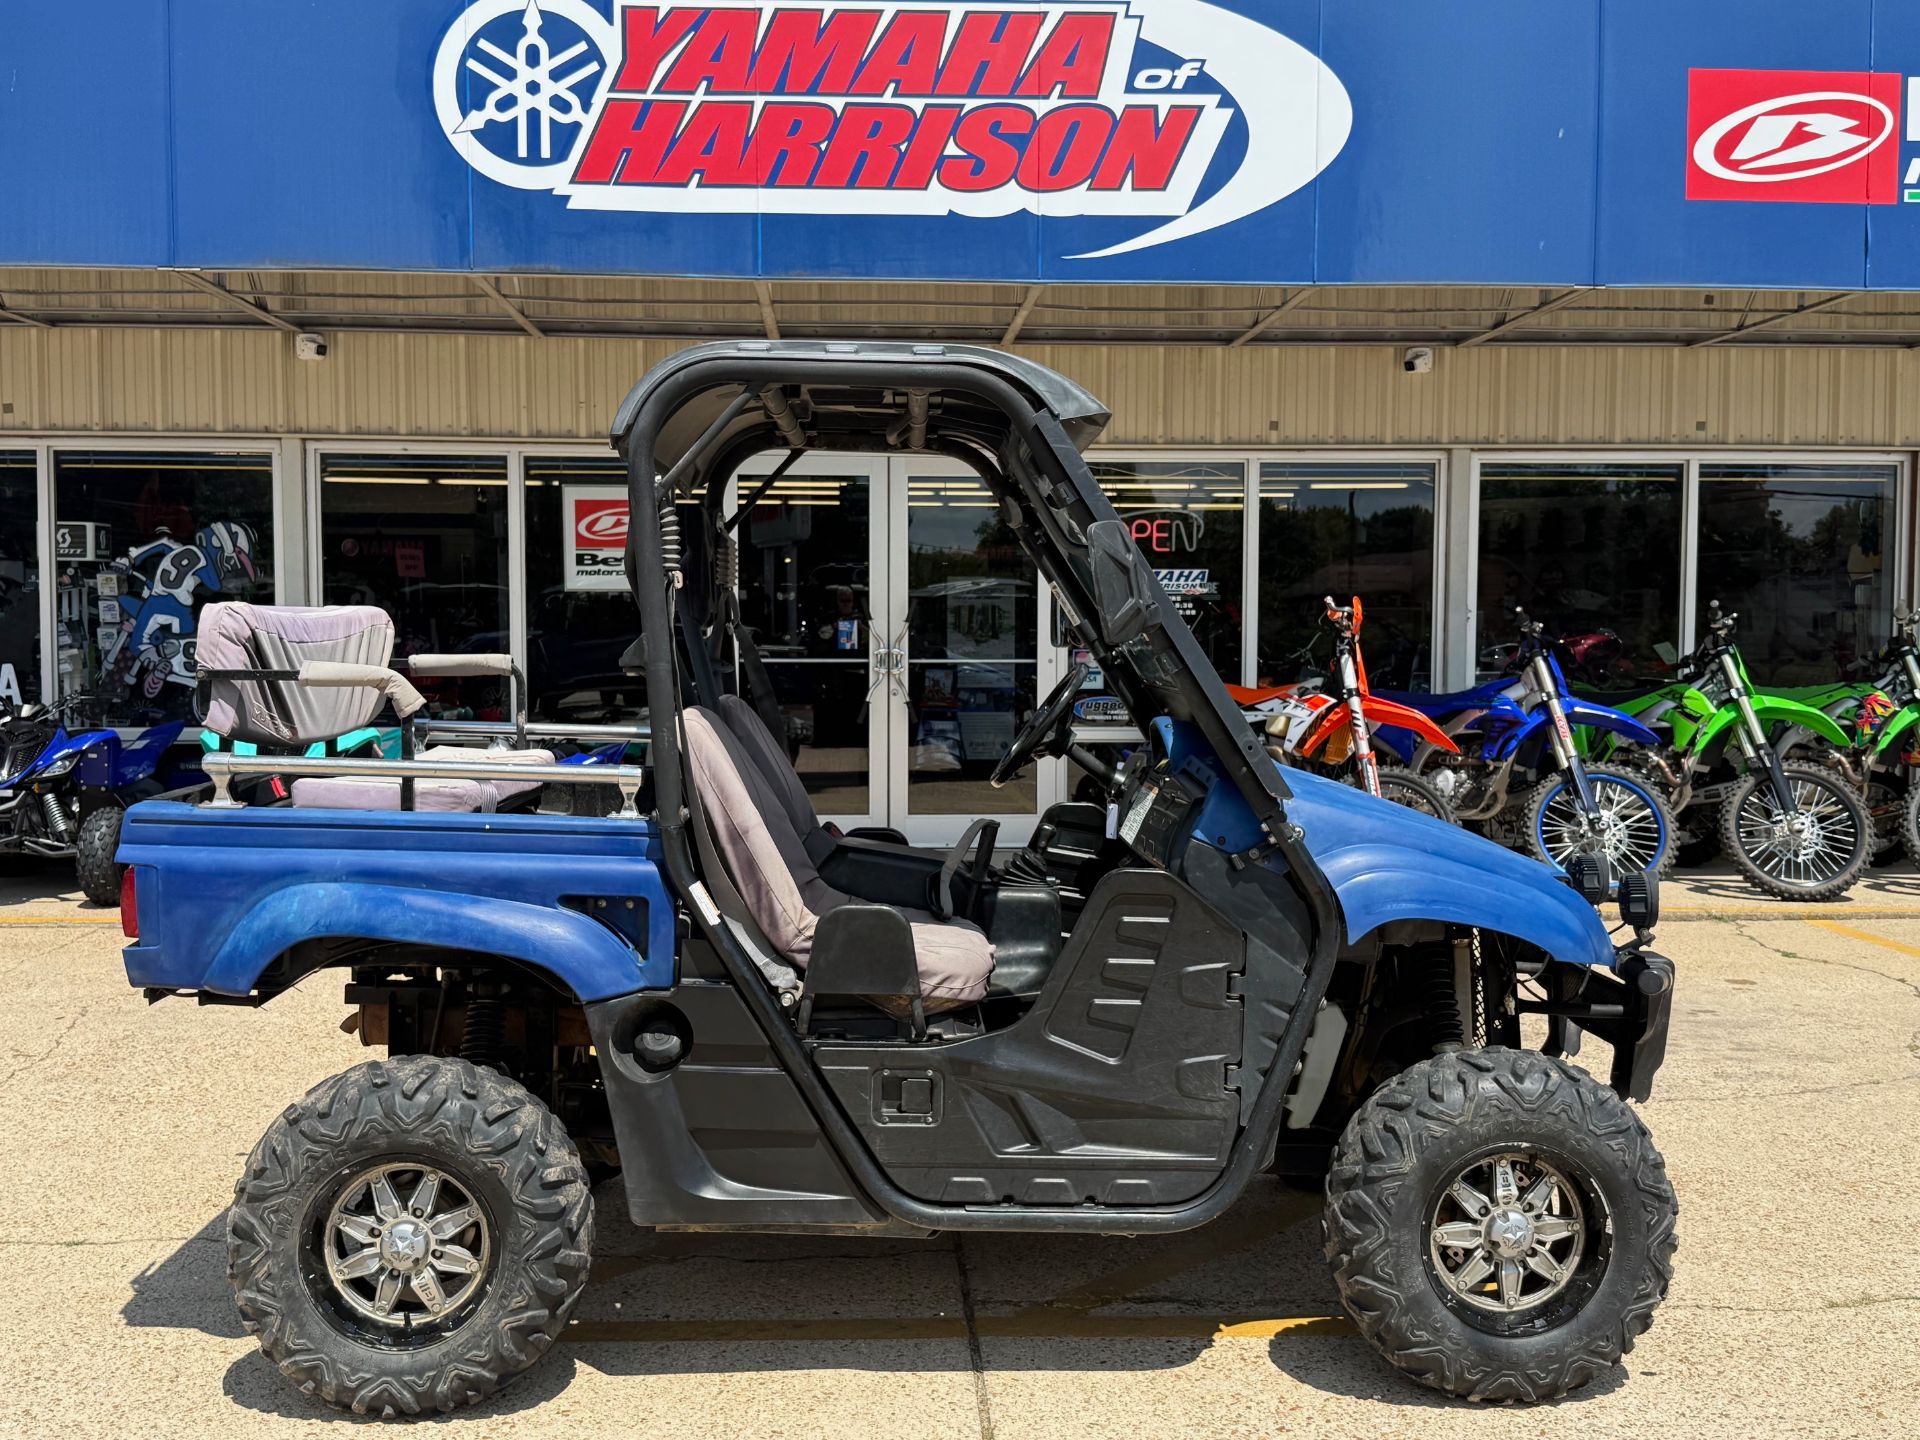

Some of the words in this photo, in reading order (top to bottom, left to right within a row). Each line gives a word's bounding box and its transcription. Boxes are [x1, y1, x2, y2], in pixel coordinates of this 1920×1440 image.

[607, 5, 1117, 99] YAMAHA
[1133, 60, 1203, 90] of
[568, 97, 1206, 194] HARRISON
[576, 553, 625, 567] Be
[1123, 519, 1198, 552] PEN
